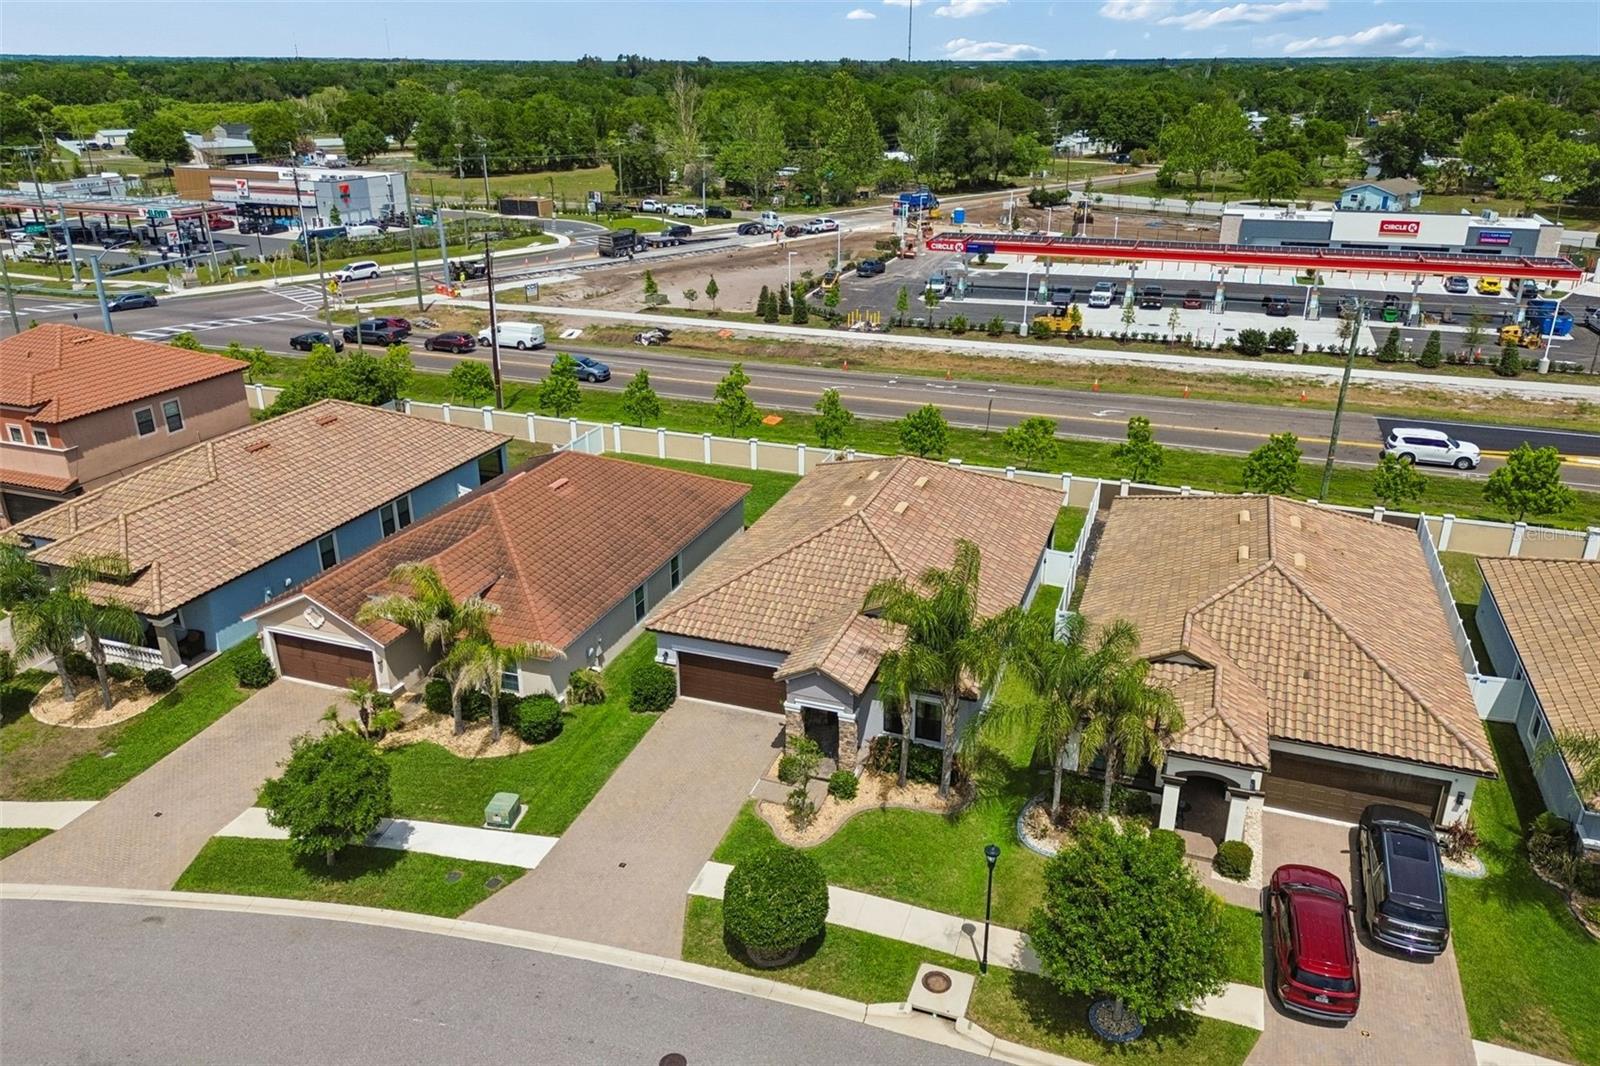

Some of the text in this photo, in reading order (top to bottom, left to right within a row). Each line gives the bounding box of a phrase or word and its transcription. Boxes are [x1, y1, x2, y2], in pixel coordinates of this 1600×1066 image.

[1382, 223, 1418, 233] CIRCLE K
[930, 242, 954, 250] CIRCLE
